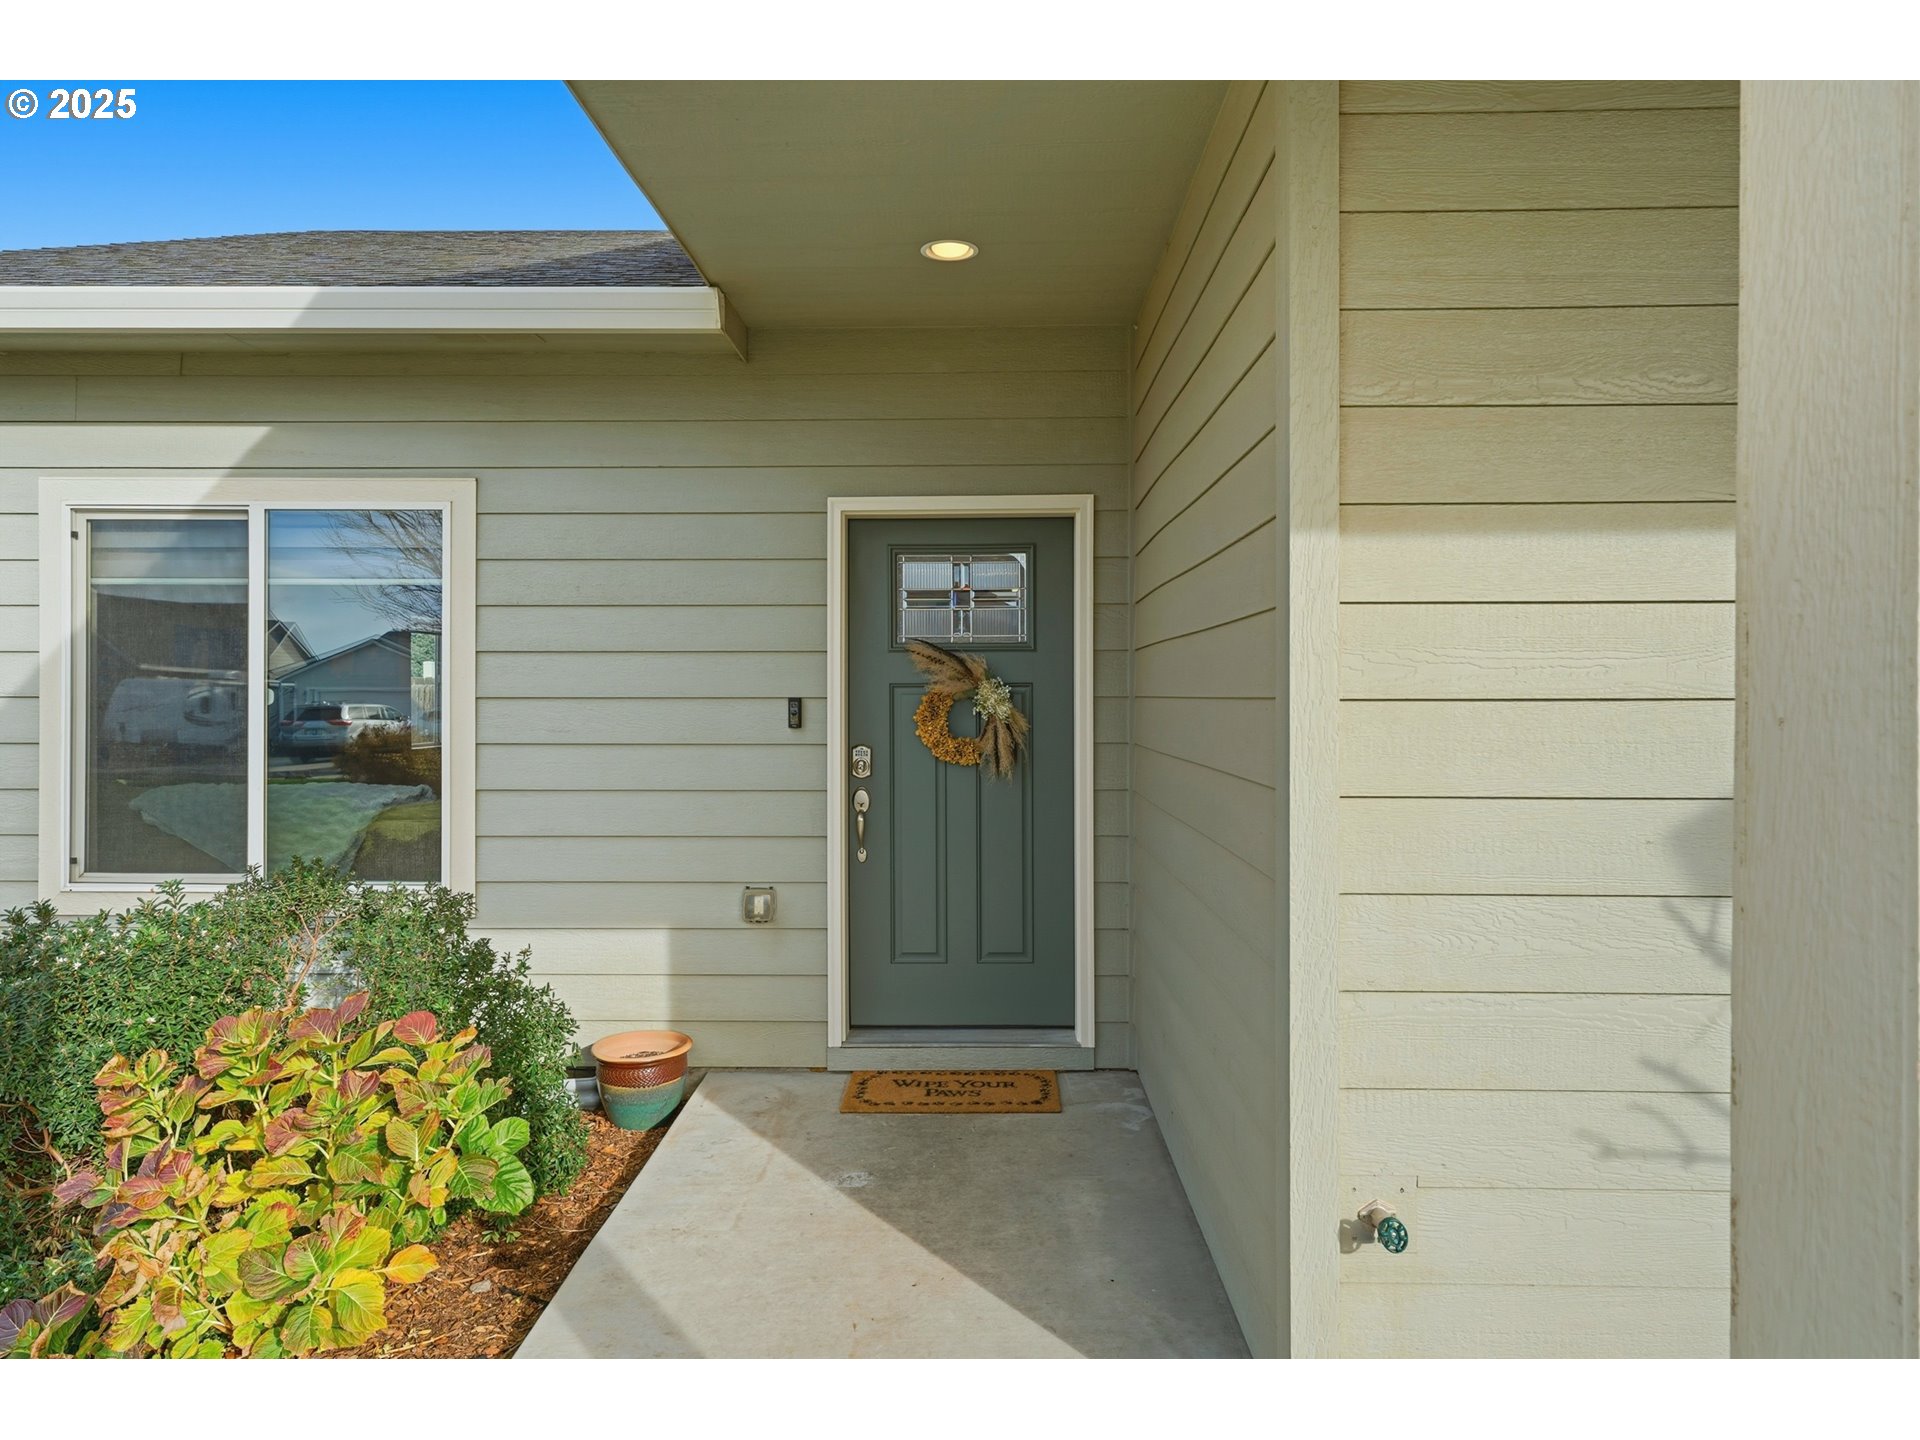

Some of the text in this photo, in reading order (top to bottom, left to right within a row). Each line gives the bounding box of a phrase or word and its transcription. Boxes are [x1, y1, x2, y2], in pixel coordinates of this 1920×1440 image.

[892, 1079, 1018, 1089] WIPE YOUR
[924, 1088, 982, 1097] PAWS
